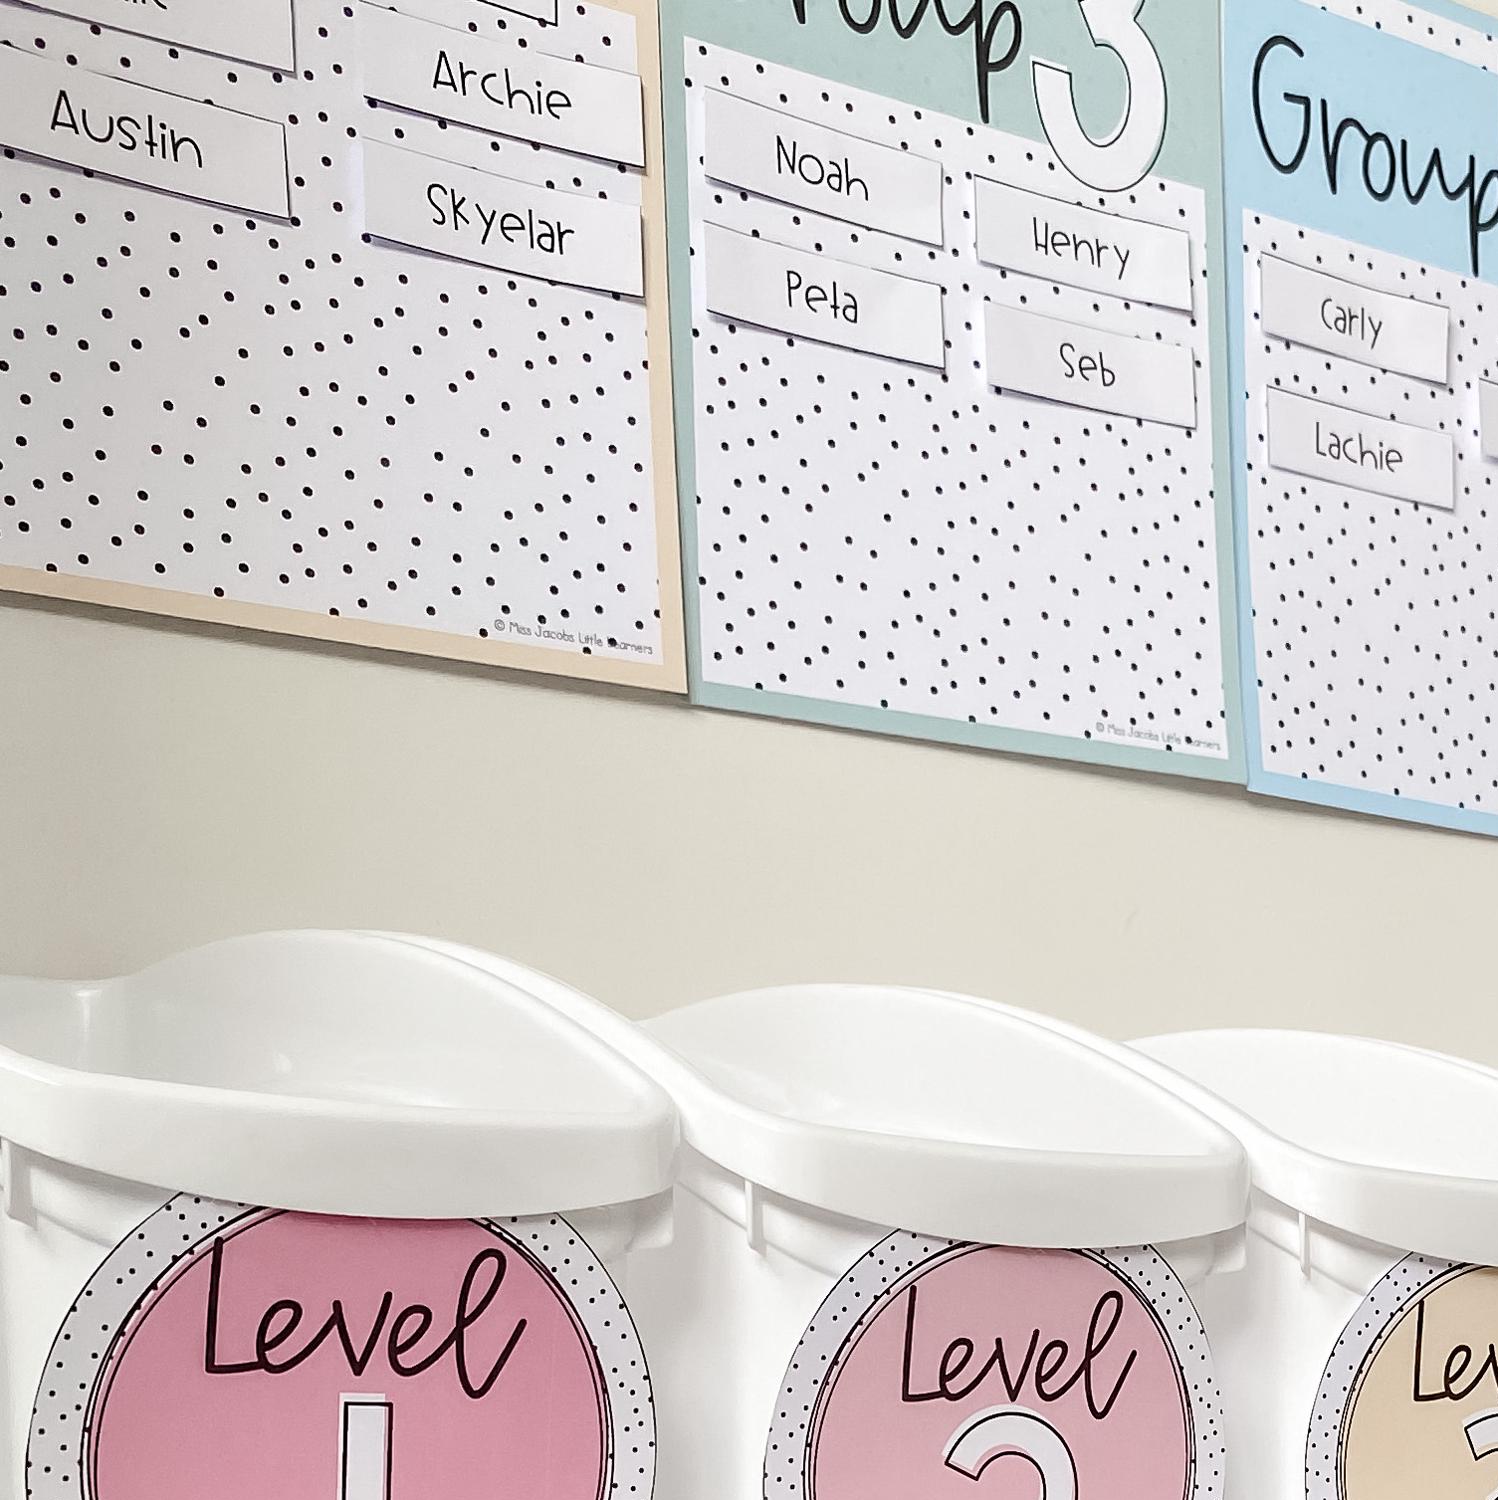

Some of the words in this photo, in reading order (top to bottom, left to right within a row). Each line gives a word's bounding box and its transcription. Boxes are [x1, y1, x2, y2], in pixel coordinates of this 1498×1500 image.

[432, 51, 572, 119] Archie
[50, 90, 203, 168] Austin
[776, 135, 868, 200] Noah
[426, 184, 575, 256] Skyelar
[1033, 217, 1130, 279] Henry
[786, 270, 858, 323] Peta
[1321, 298, 1382, 350] Carly
[1060, 343, 1115, 386] Seb
[1315, 422, 1403, 472] Lachie
[205, 1236, 527, 1399] Level
[902, 1285, 1137, 1420] Level
